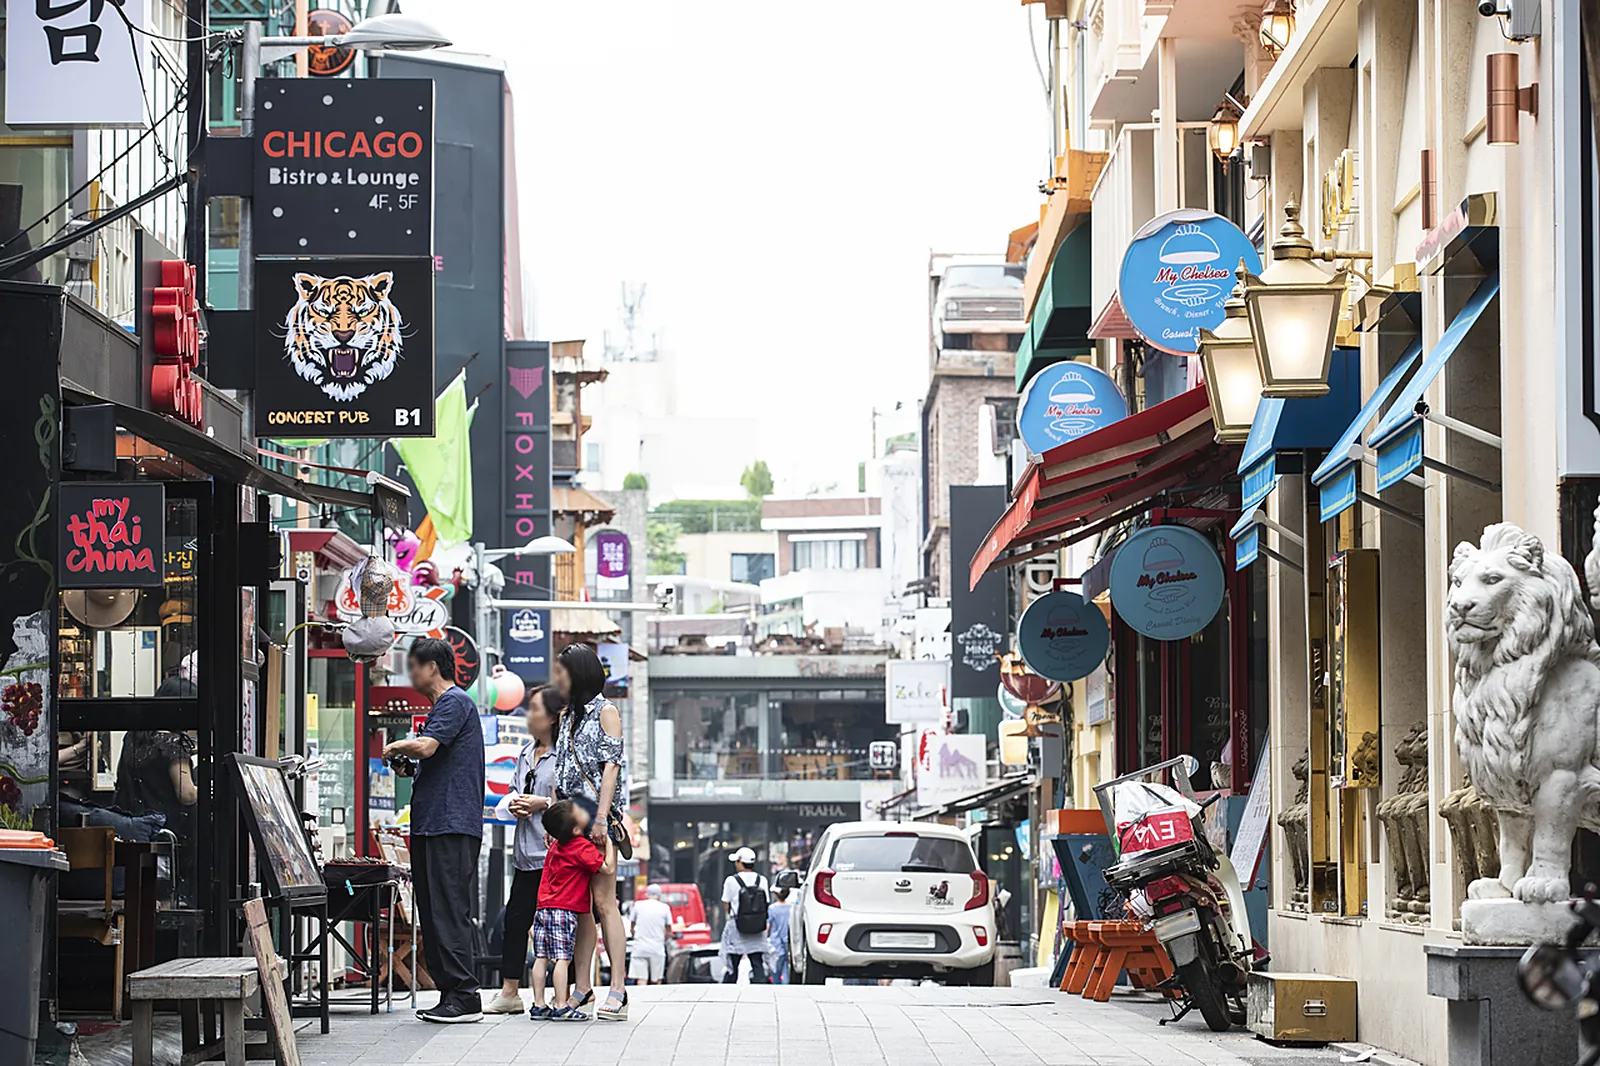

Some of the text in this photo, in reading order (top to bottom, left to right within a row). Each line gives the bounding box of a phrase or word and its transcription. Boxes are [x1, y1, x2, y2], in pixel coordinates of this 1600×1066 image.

[263, 131, 423, 158] CHICAGO
[269, 167, 419, 190] Bistro & Lounge
[368, 194, 419, 212] 4F, 5F
[1153, 264, 1230, 286] My Chelsea
[1162, 327, 1193, 339] Casual
[268, 409, 421, 426] CONCERT PUB B1
[1044, 403, 1102, 420] My Chelsea
[92, 497, 130, 521] my
[515, 411, 534, 585] FOXHOE
[66, 510, 142, 547] thai
[65, 532, 156, 573] china
[965, 645, 994, 655] MING
[377, 717, 411, 725] WELCOM
